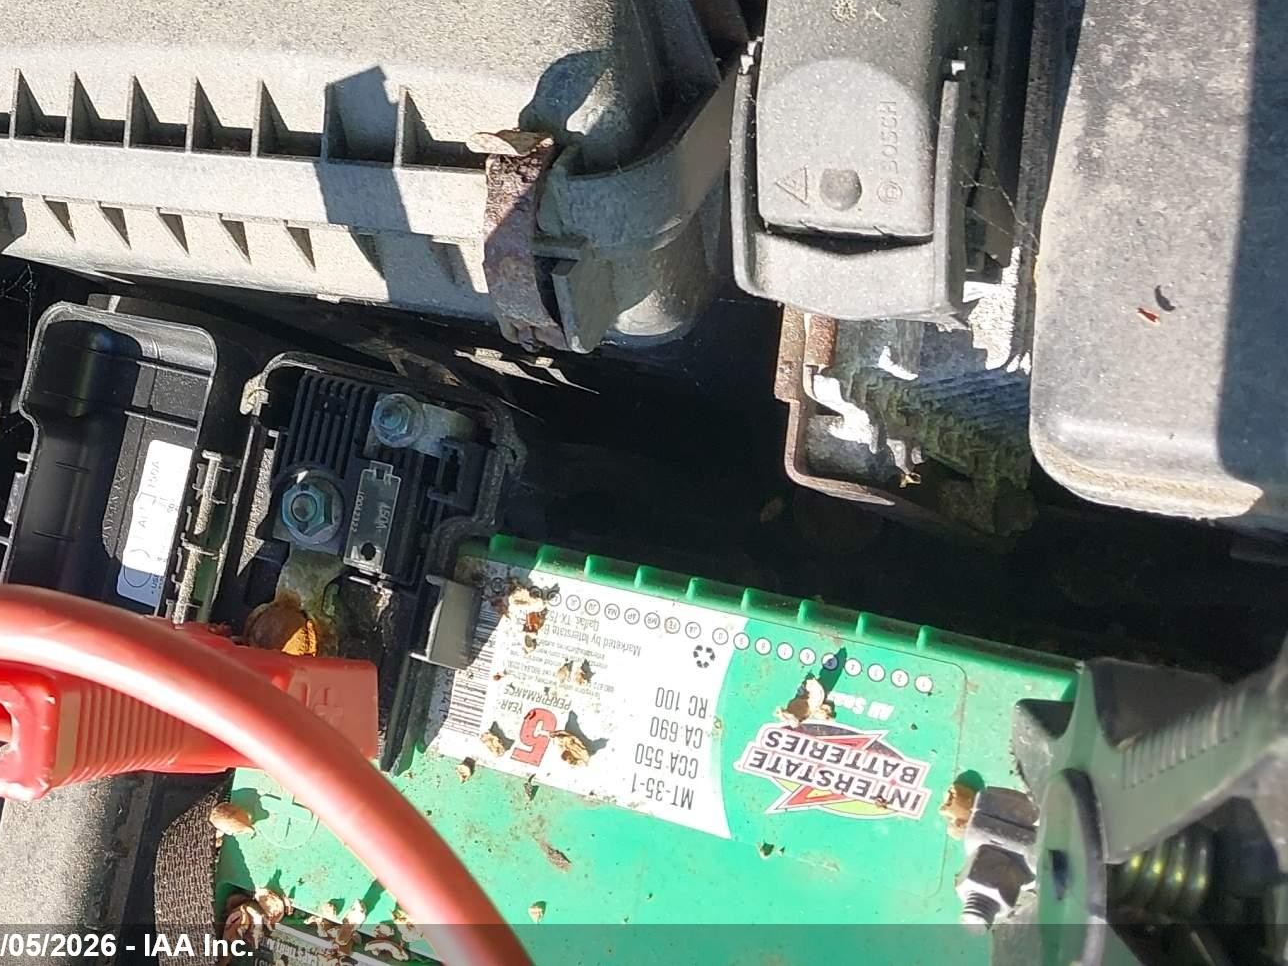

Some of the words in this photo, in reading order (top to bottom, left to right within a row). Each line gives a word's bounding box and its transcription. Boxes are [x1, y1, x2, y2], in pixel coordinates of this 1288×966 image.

[879, 100, 898, 176] BOSCH
[590, 634, 601, 647] by
[603, 638, 642, 657] Marketed
[503, 684, 572, 710] PERFORMANCE
[655, 686, 681, 712] 100
[688, 695, 708, 719] RC
[510, 707, 558, 768] 5
[649, 716, 679, 742] 690
[682, 724, 703, 749] CA
[634, 742, 664, 770] 550
[670, 752, 699, 780] CCA
[764, 730, 920, 784] BATTERIES
[630, 772, 695, 810] MT-35-1
[748, 750, 923, 812] INTERSTATE
